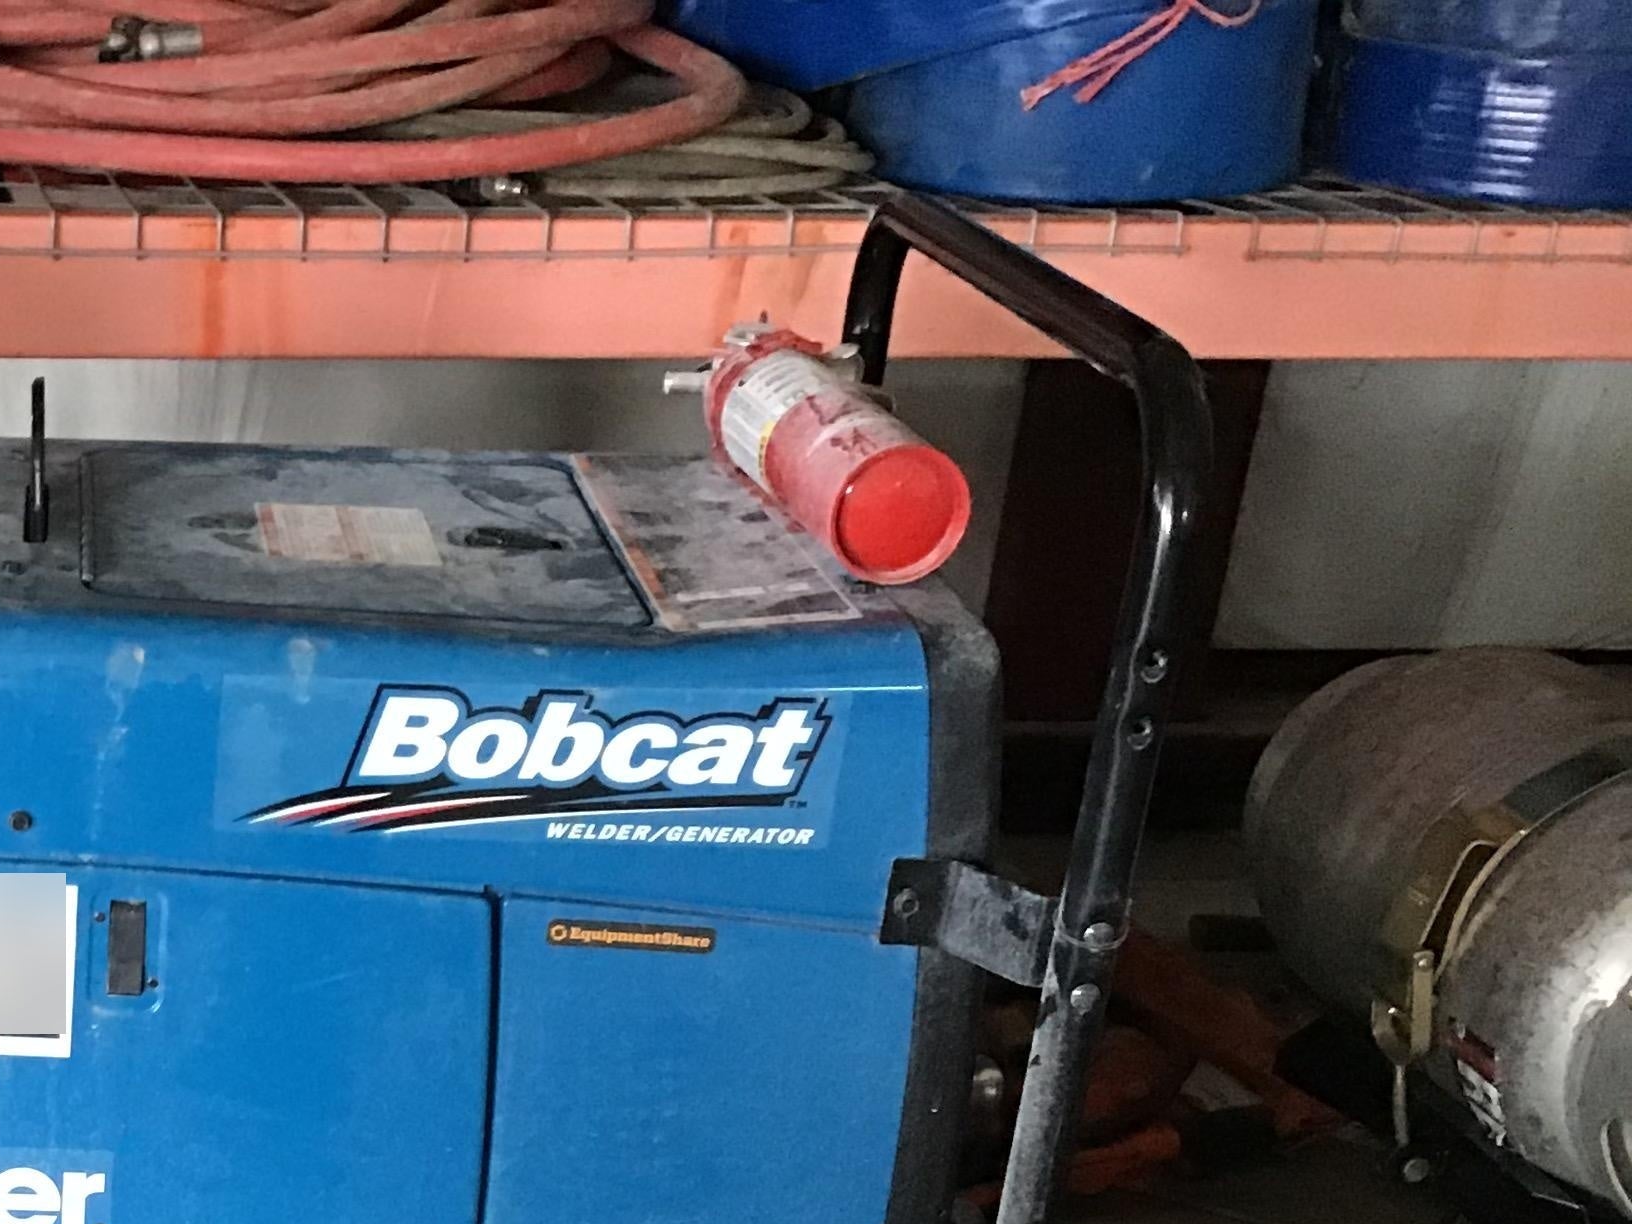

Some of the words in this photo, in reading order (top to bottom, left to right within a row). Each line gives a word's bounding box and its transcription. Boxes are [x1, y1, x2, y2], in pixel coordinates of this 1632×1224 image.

[358, 696, 814, 787] Bobcat
[547, 822, 815, 845] WELDER/GENERATOR
[569, 926, 712, 949] EquipmentShare
